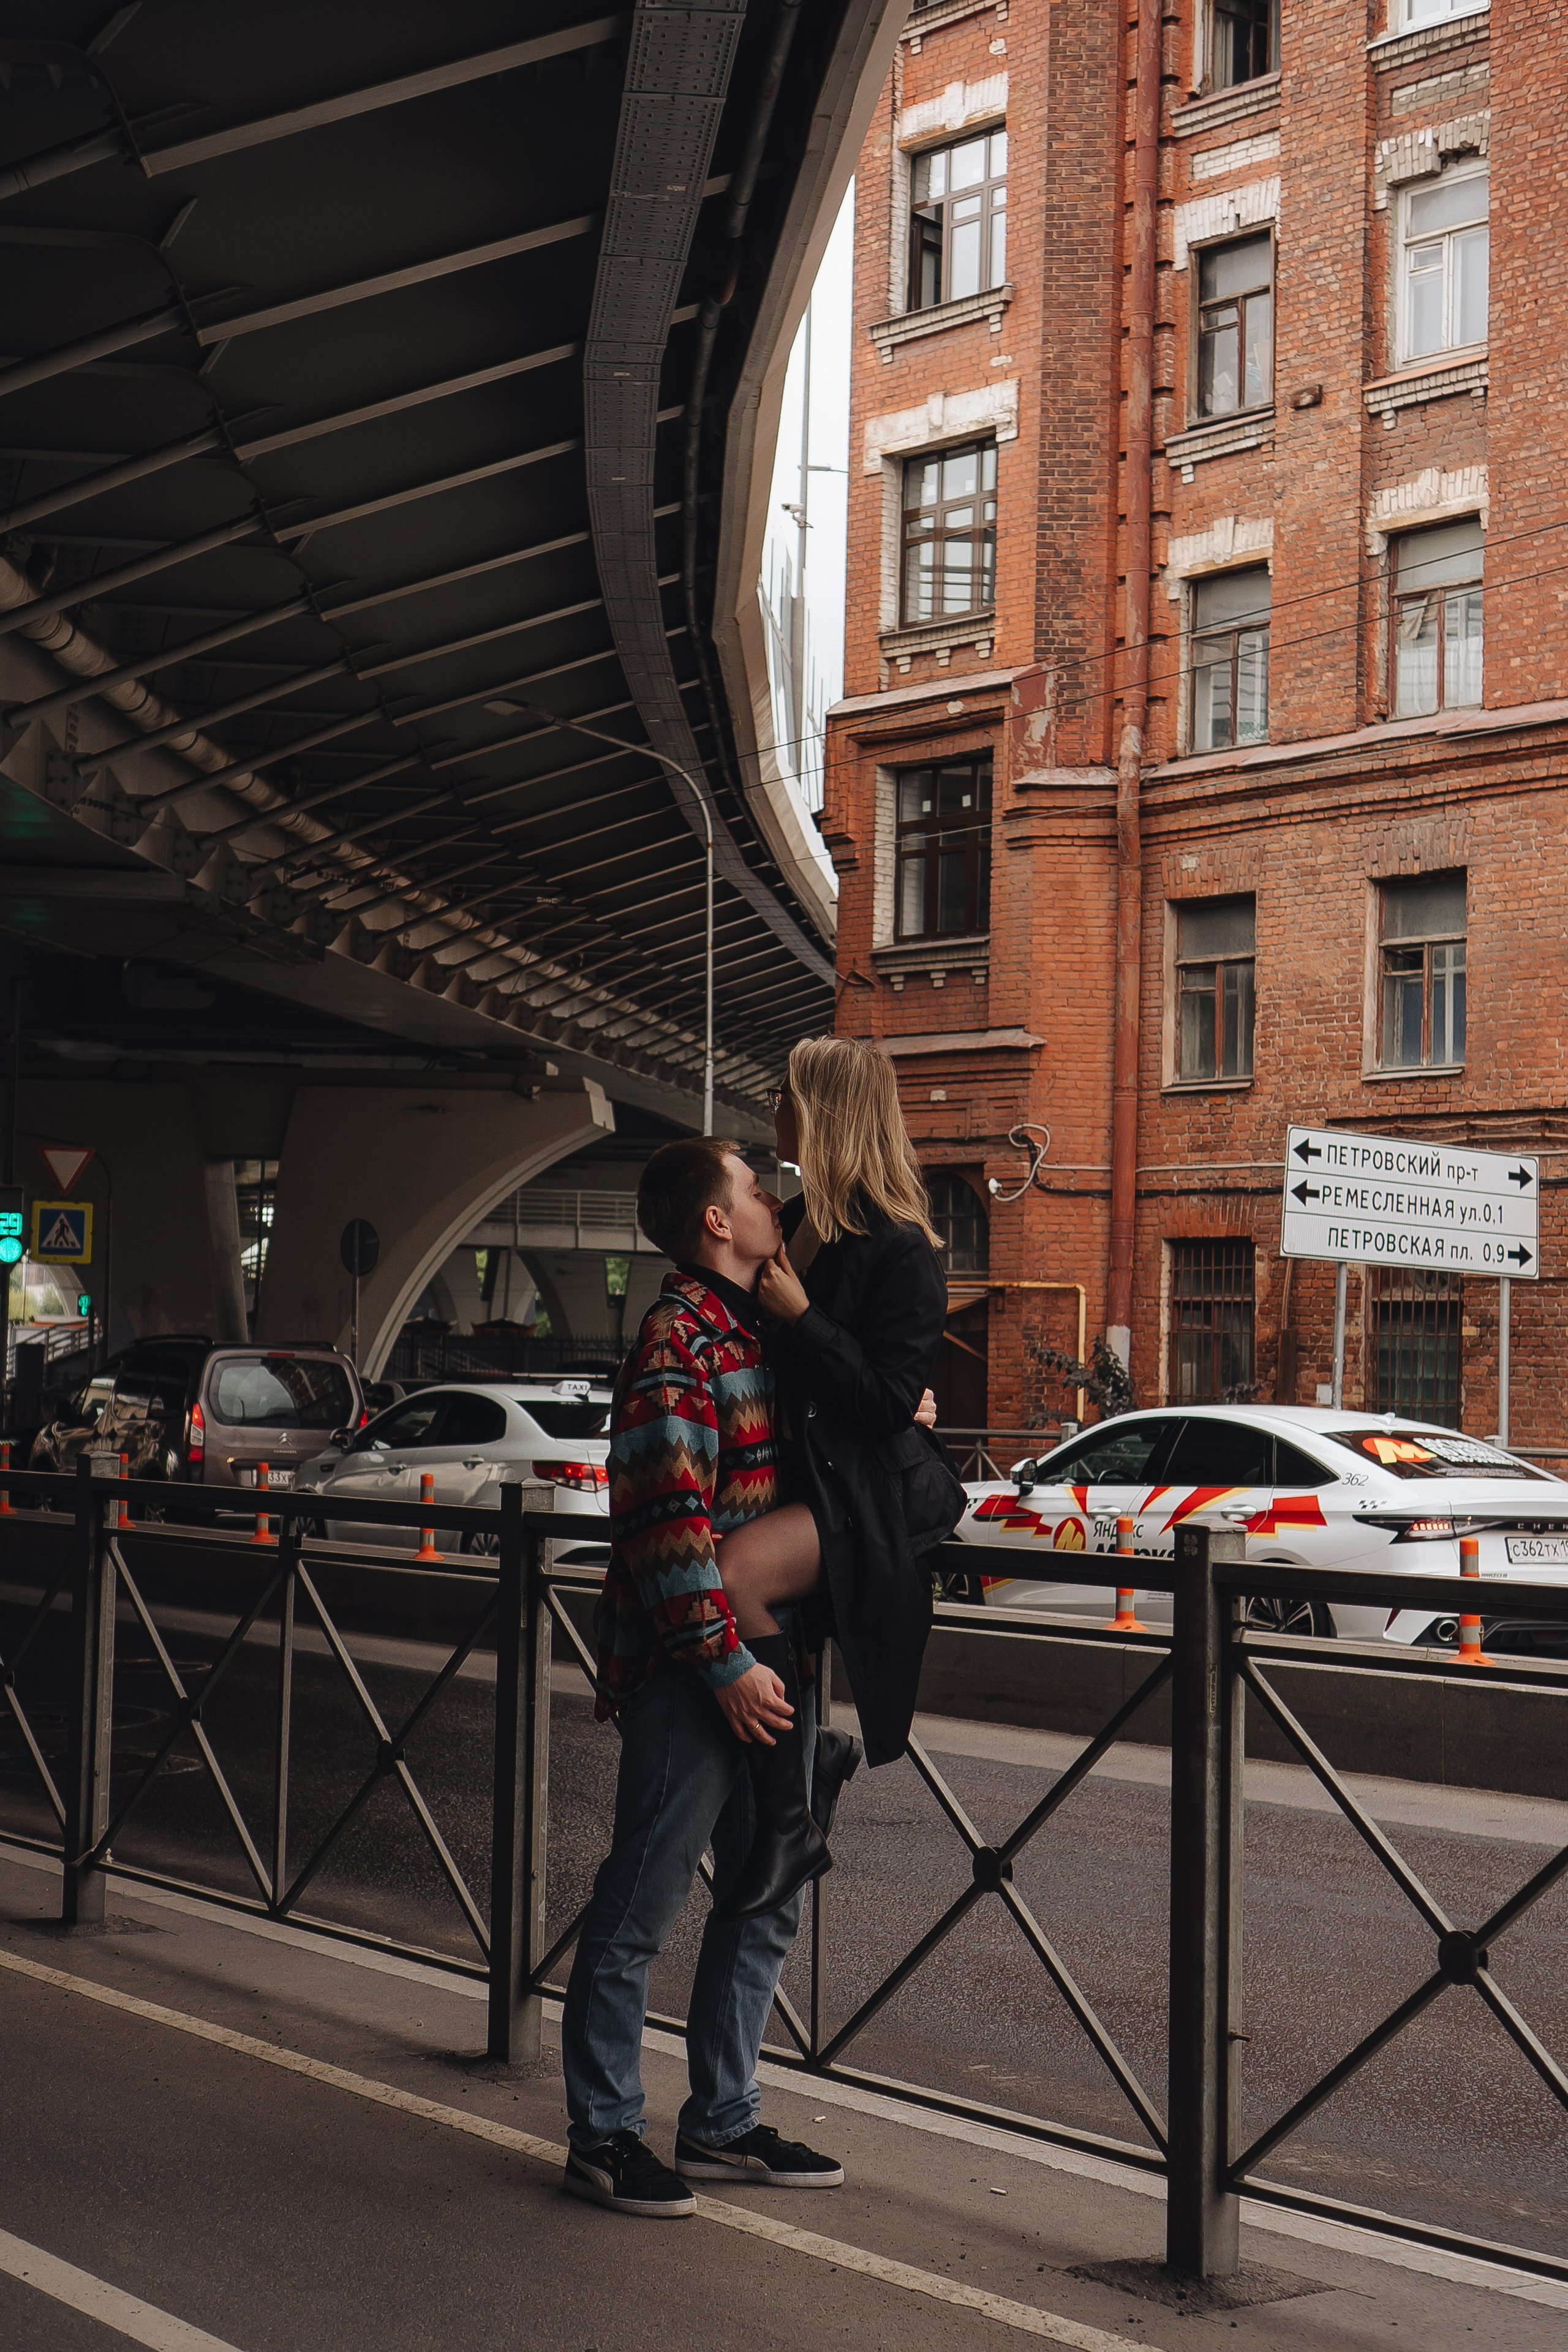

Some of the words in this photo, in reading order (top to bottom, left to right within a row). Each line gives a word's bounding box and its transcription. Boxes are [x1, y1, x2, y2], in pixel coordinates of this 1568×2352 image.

[1327, 1144, 1441, 1177] ПЕТРОВСКИЙ
[1447, 1165, 1479, 1185] пр-т
[1322, 1185, 1454, 1219] РЕМЕСЛЕННАЯ
[0, 1213, 22, 1236] 29
[1328, 1227, 1444, 1258] ПЕТРОВСКАЯ
[1450, 1245, 1472, 1261] пл.
[1483, 1243, 1505, 1264] 0,9
[1341, 1472, 1369, 1486] 362
